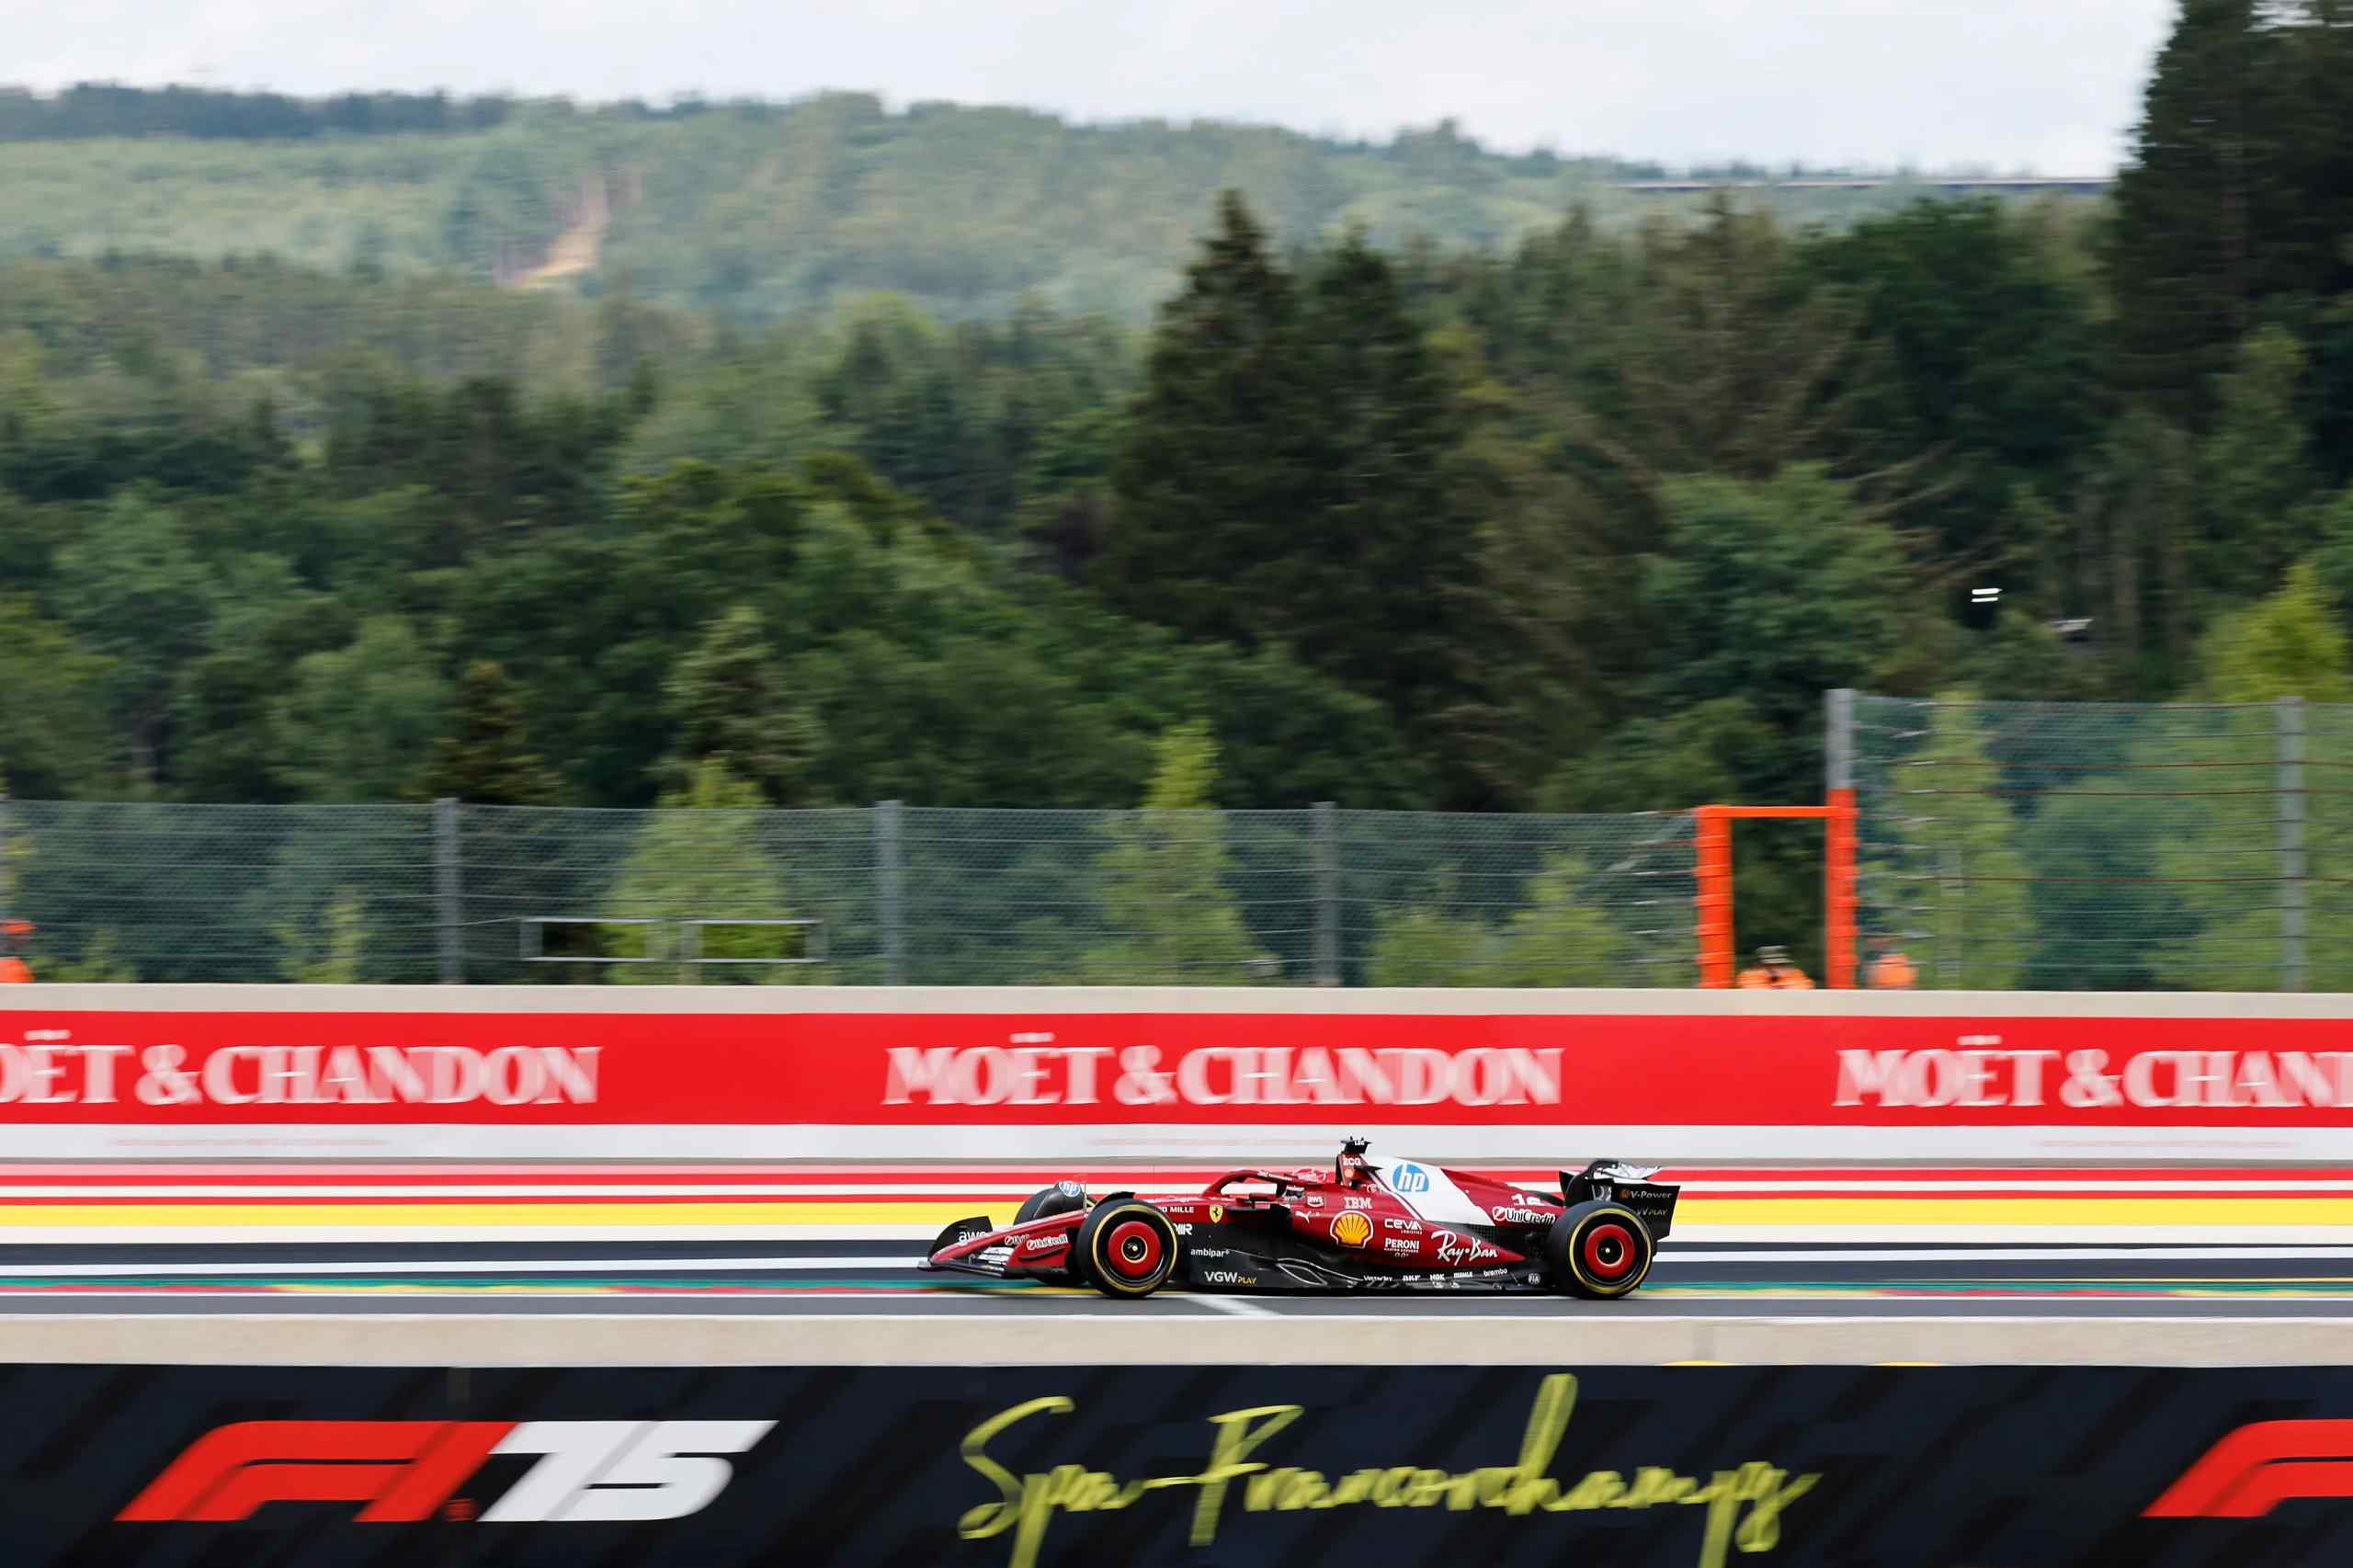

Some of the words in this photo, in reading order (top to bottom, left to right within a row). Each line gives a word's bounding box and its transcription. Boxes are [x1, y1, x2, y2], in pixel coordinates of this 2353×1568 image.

[135, 1044, 203, 1105] &
[202, 1045, 603, 1105] CHANDON
[1113, 1045, 1180, 1105] &
[1176, 1046, 1564, 1106] CHANDON
[2059, 1048, 2125, 1108] &
[1396, 1165, 1428, 1192] hp
[1344, 1198, 1373, 1210] IBM
[1506, 1206, 1556, 1224] UniCredit
[1190, 1247, 1226, 1258] ambipar
[1384, 1237, 1420, 1250] PERONI
[1204, 1271, 1238, 1283] VGW
[1237, 1277, 1257, 1285] PLAY
[1483, 1267, 1508, 1277] brembo
[474, 1420, 780, 1522] 75
